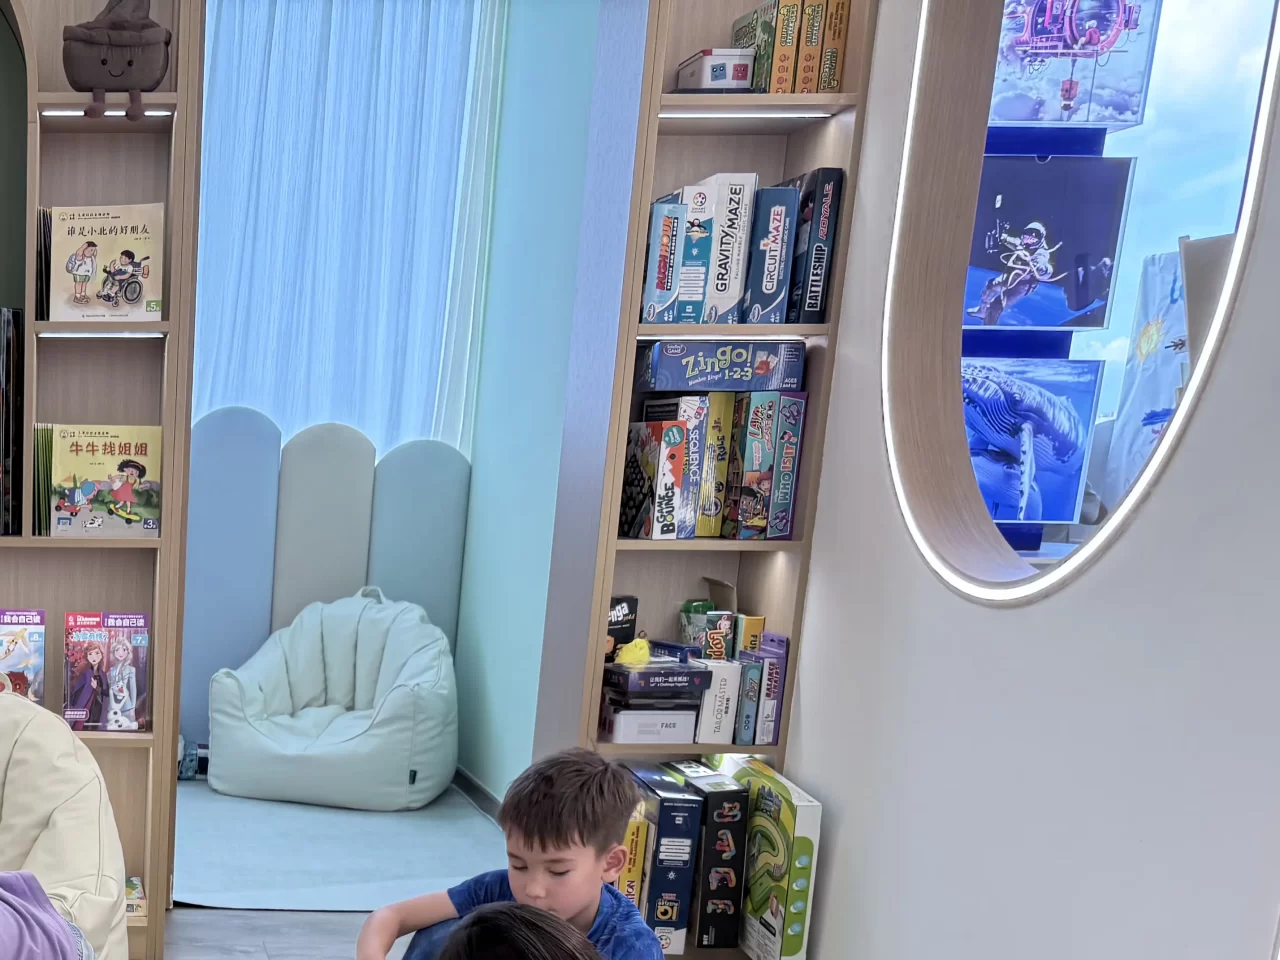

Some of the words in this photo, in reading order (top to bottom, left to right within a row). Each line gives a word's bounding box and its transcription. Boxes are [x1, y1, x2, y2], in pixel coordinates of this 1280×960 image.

[715, 226, 735, 292] GRAVITY
[728, 186, 742, 230] MAZE
[770, 207, 783, 245] MAZE
[807, 244, 827, 309] BATTLESHIP
[818, 181, 834, 241] ROYALE
[764, 246, 778, 291] CIRCUIT
[681, 343, 754, 378] Zingo!
[724, 367, 753, 381] 1-2-3
[748, 405, 764, 440] LAVA
[69, 440, 149, 457] 牛牛找姐姐
[689, 429, 700, 483] SEQUENCE
[779, 472, 793, 503] WHO
[656, 493, 666, 524] GAME
[660, 482, 676, 535] BOUNCE
